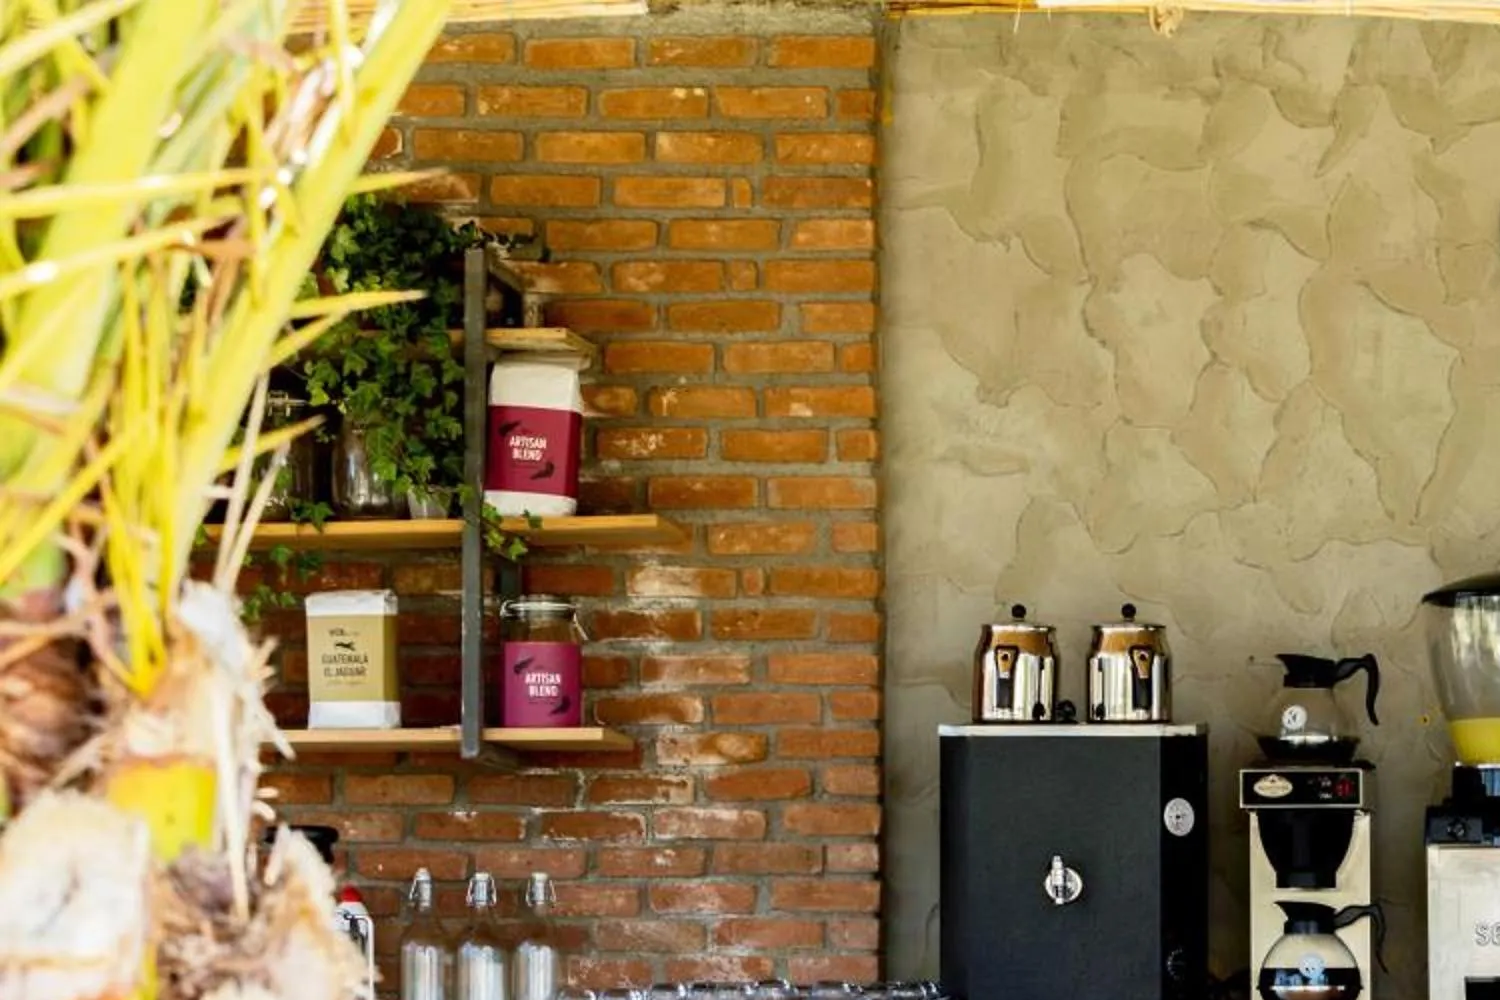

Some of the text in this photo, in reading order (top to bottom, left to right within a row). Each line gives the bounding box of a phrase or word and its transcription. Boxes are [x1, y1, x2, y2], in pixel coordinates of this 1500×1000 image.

[509, 435, 547, 449] ARTISAN
[512, 448, 543, 461] BLEND
[322, 653, 369, 664] GUATEMALA
[525, 672, 561, 685] ARTISAN
[529, 685, 558, 697] BLEND
